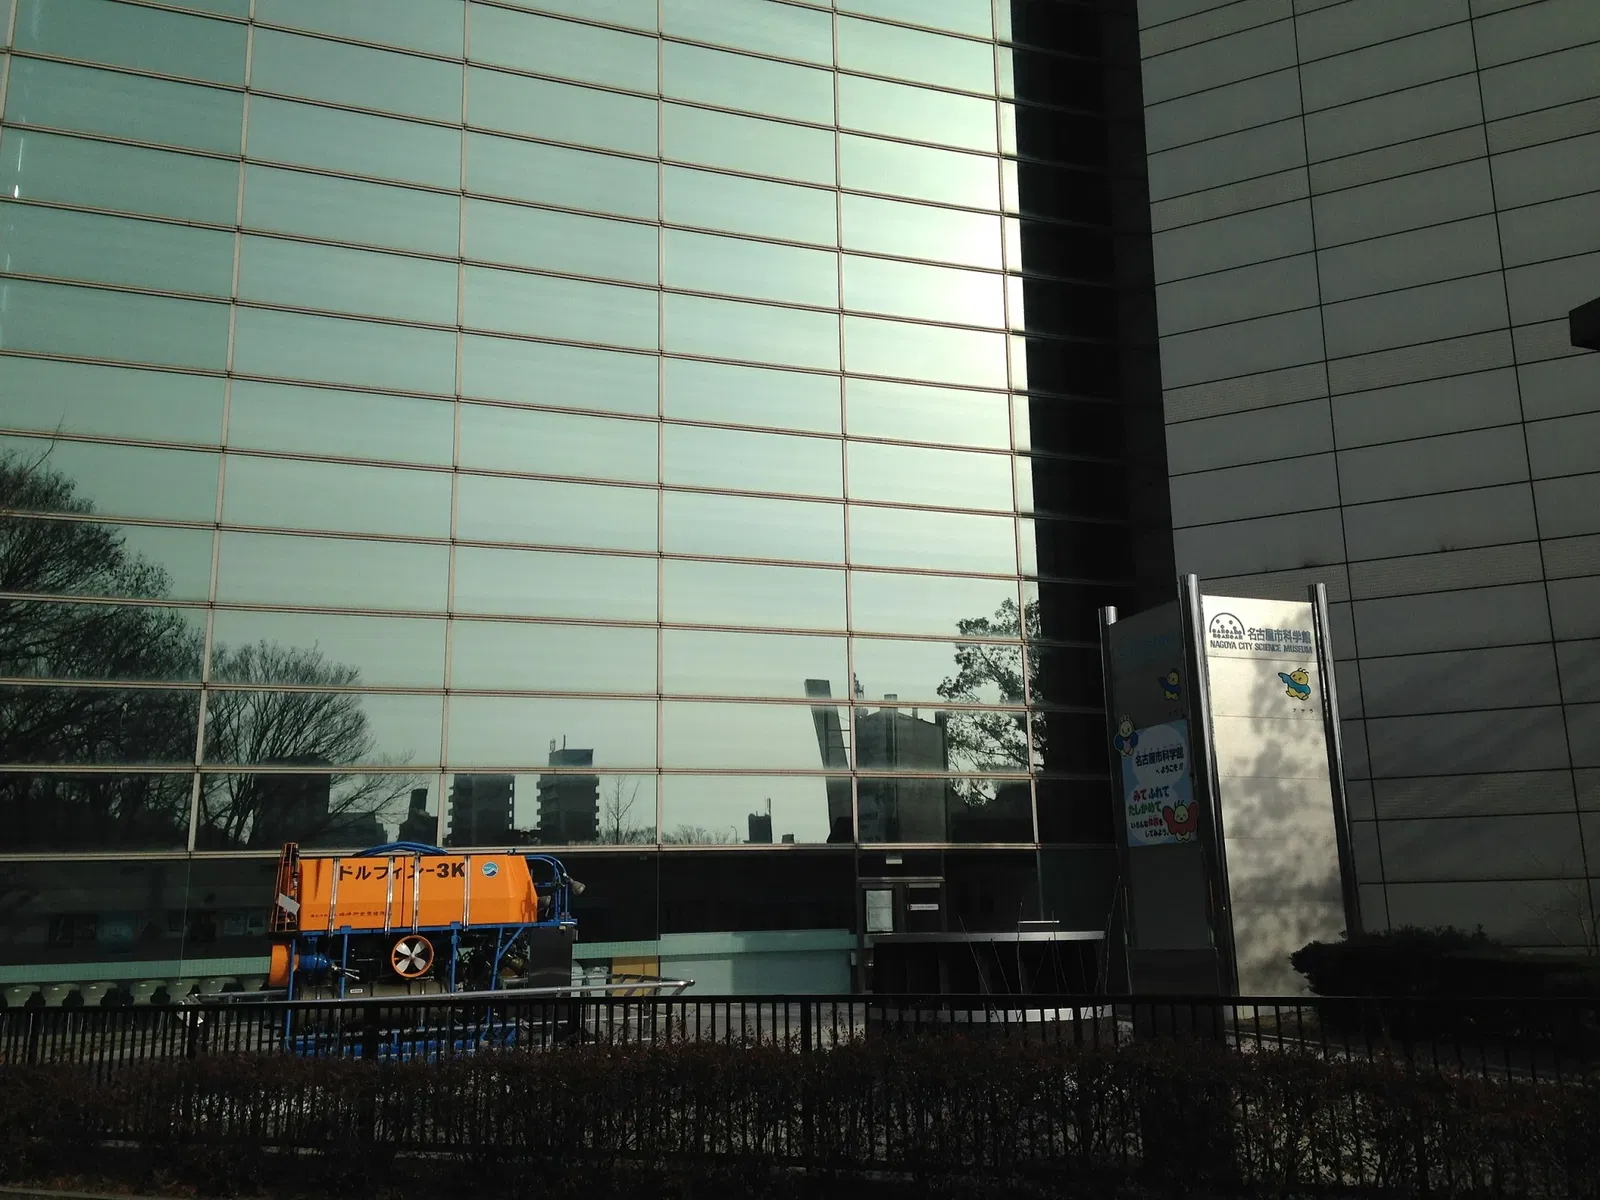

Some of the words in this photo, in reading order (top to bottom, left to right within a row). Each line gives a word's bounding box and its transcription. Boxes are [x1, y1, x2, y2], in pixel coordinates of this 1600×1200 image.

[1247, 627, 1311, 644] 名古屋市科学館
[1210, 640, 1237, 650] NAGOYA
[1239, 641, 1253, 651] CITY
[1254, 643, 1281, 653] SCIENCE
[1283, 645, 1313, 654] MUSEUM
[1136, 747, 1184, 766] 名古屋市科学館
[1129, 801, 1161, 816] たしかめて
